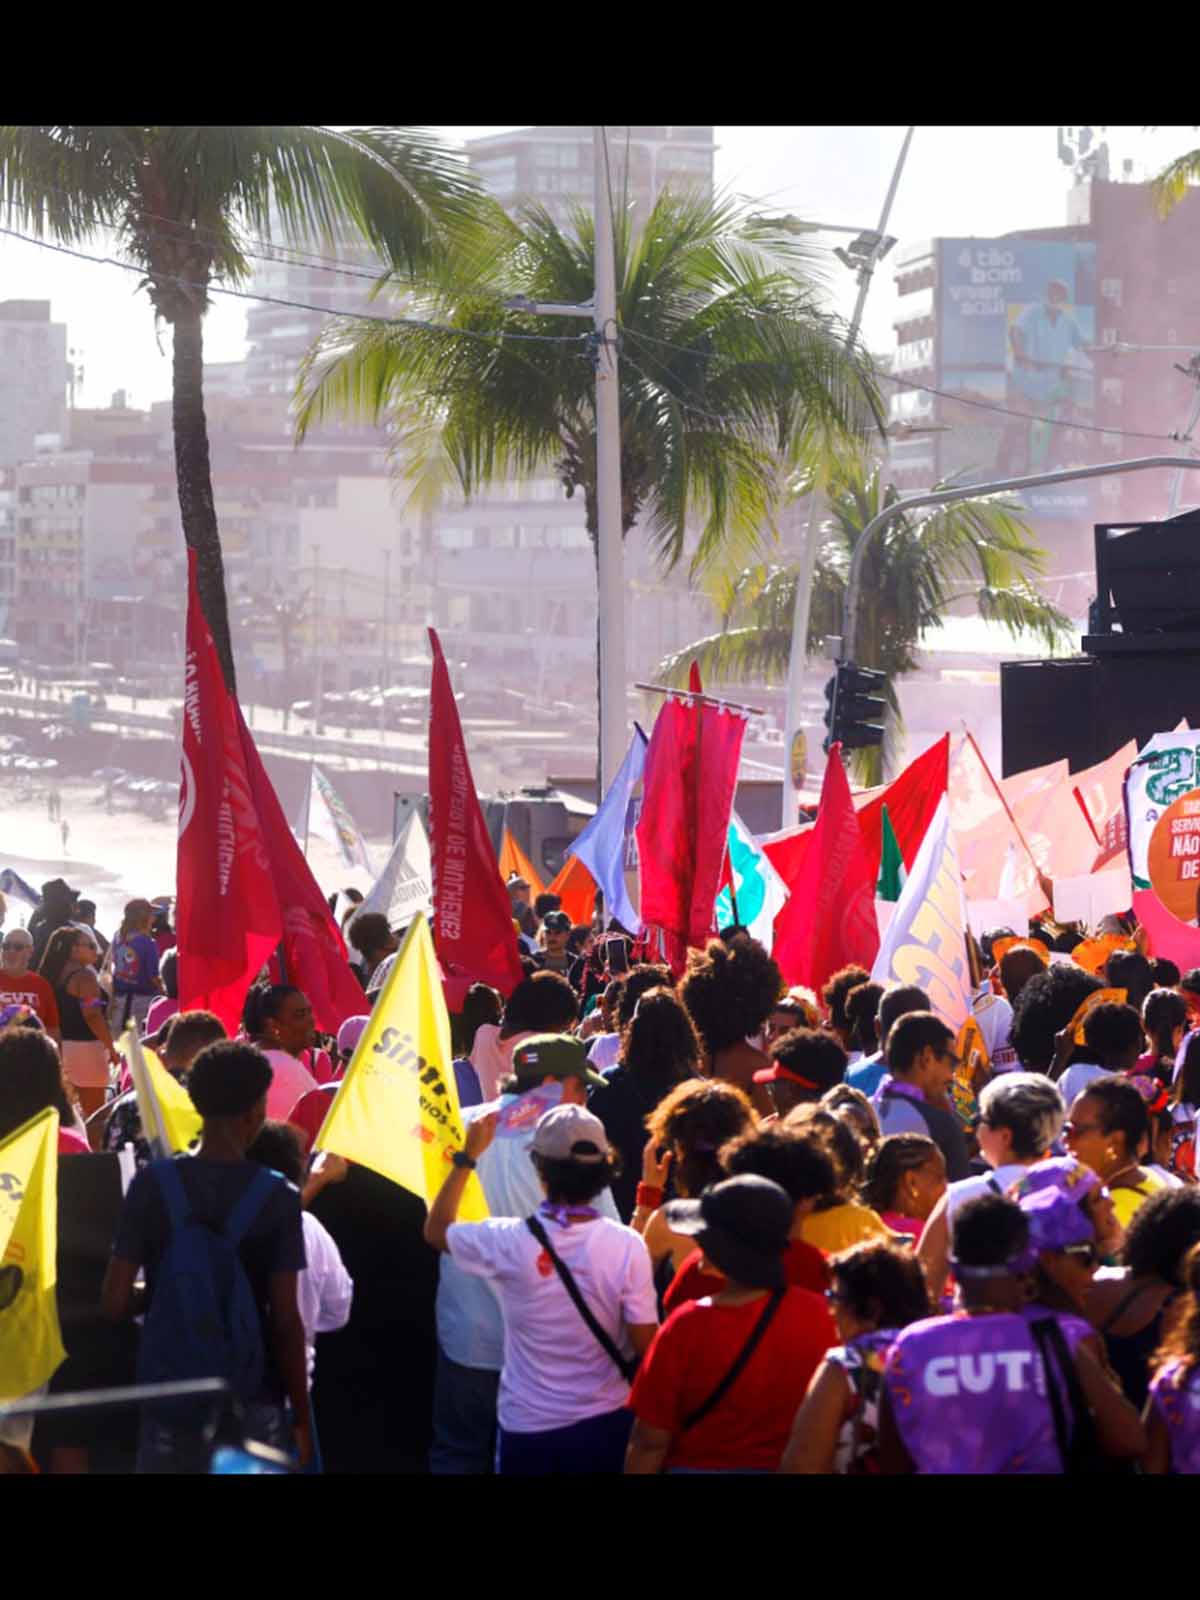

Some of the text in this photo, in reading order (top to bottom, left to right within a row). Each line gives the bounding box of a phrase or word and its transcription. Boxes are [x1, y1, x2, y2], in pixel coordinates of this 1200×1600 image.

[977, 248, 1015, 267] tão
[971, 266, 1022, 284] bom
[1172, 834, 1200, 856] NÃO
[1181, 860, 1200, 880] DE
[924, 1350, 1032, 1397] CUT
